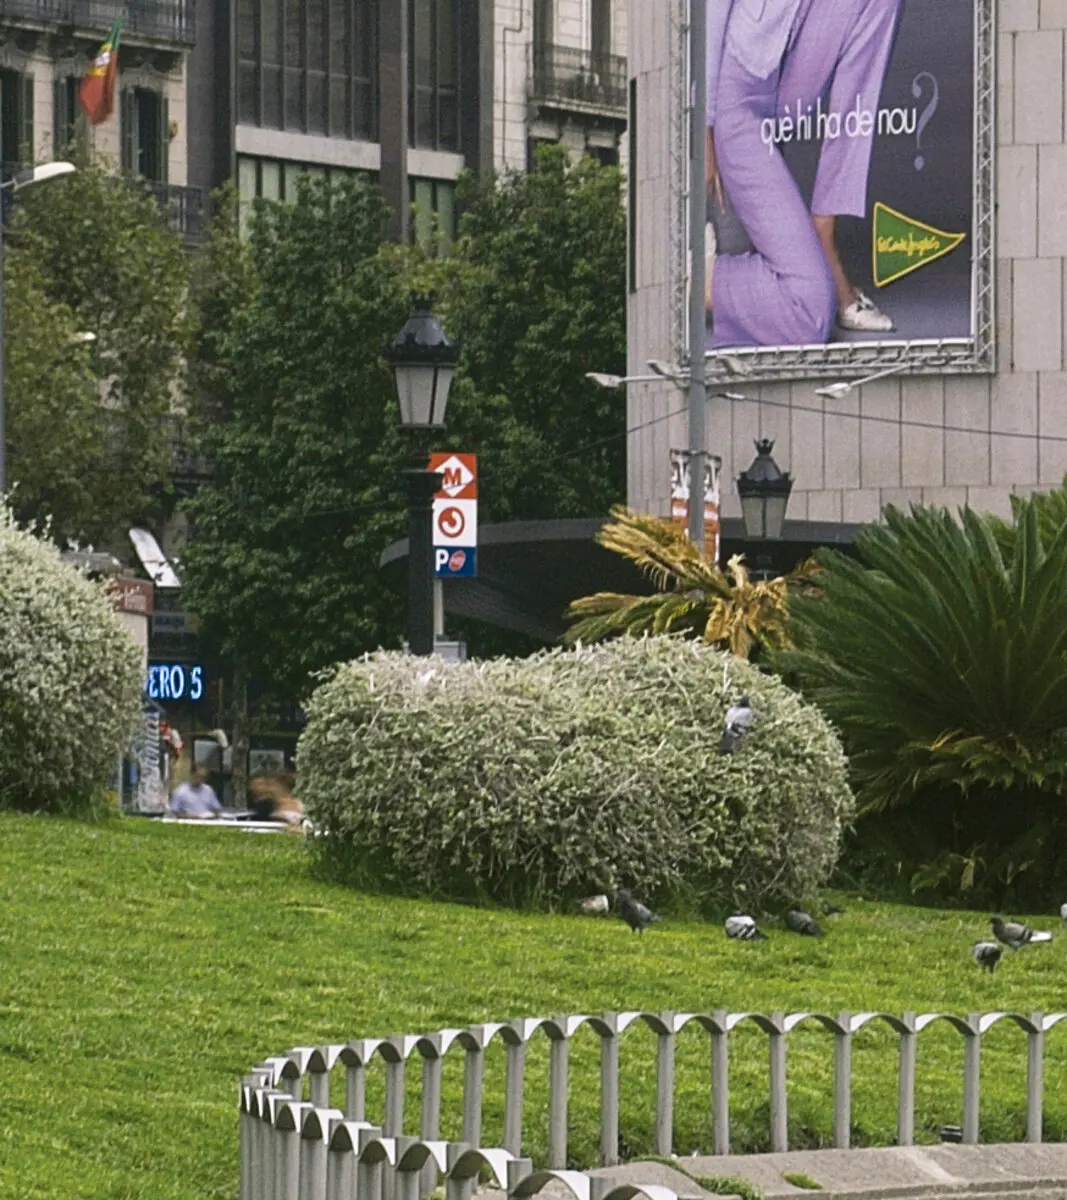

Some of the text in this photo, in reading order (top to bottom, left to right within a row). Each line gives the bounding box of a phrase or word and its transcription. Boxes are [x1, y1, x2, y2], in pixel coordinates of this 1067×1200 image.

[761, 104, 794, 155] què
[796, 98, 812, 141] hi
[816, 96, 842, 141] ha
[845, 93, 874, 138] de
[444, 467, 462, 486] M
[435, 548, 449, 572] P
